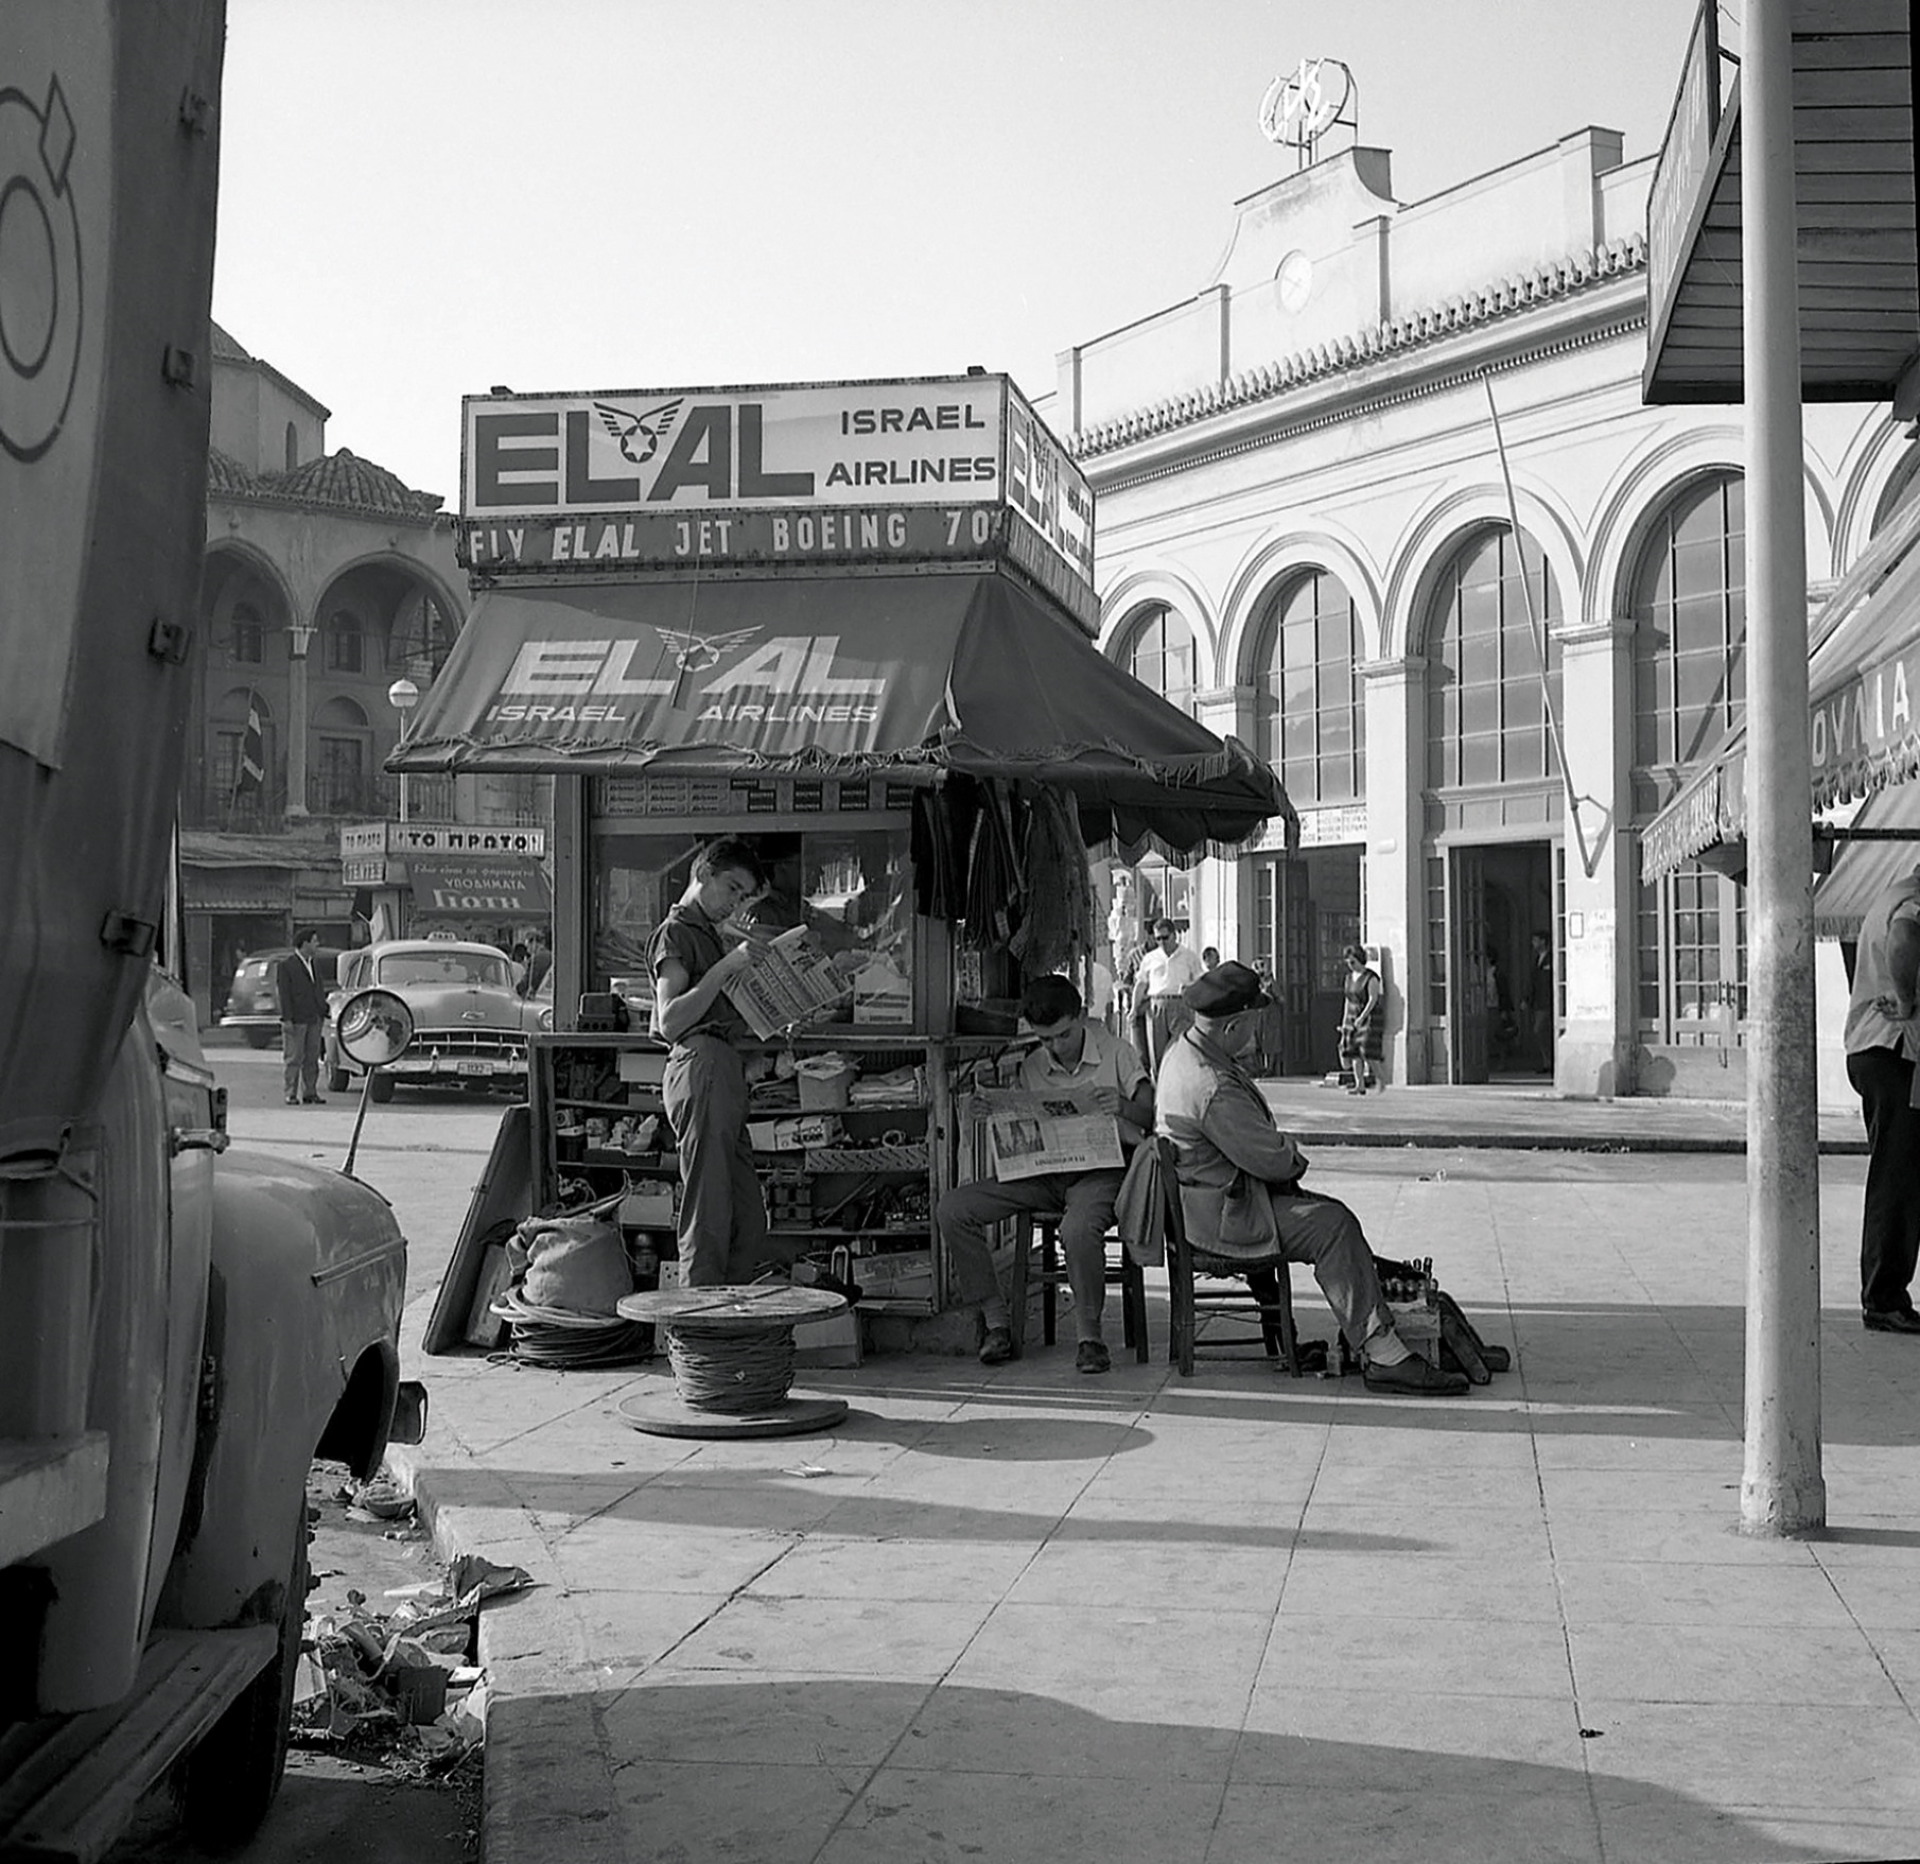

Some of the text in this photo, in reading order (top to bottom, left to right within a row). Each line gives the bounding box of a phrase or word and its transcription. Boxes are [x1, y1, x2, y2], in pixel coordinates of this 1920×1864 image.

[841, 404, 986, 436] ISRAEL
[825, 456, 997, 488] AIRLINES
[551, 524, 640, 561] ELAL
[674, 520, 732, 556] JET
[772, 513, 908, 552] BOEING
[486, 704, 878, 724] ISRAEL AIRLINES
[444, 877, 527, 892] ΥΠΟΔΗΜΑΤΑ
